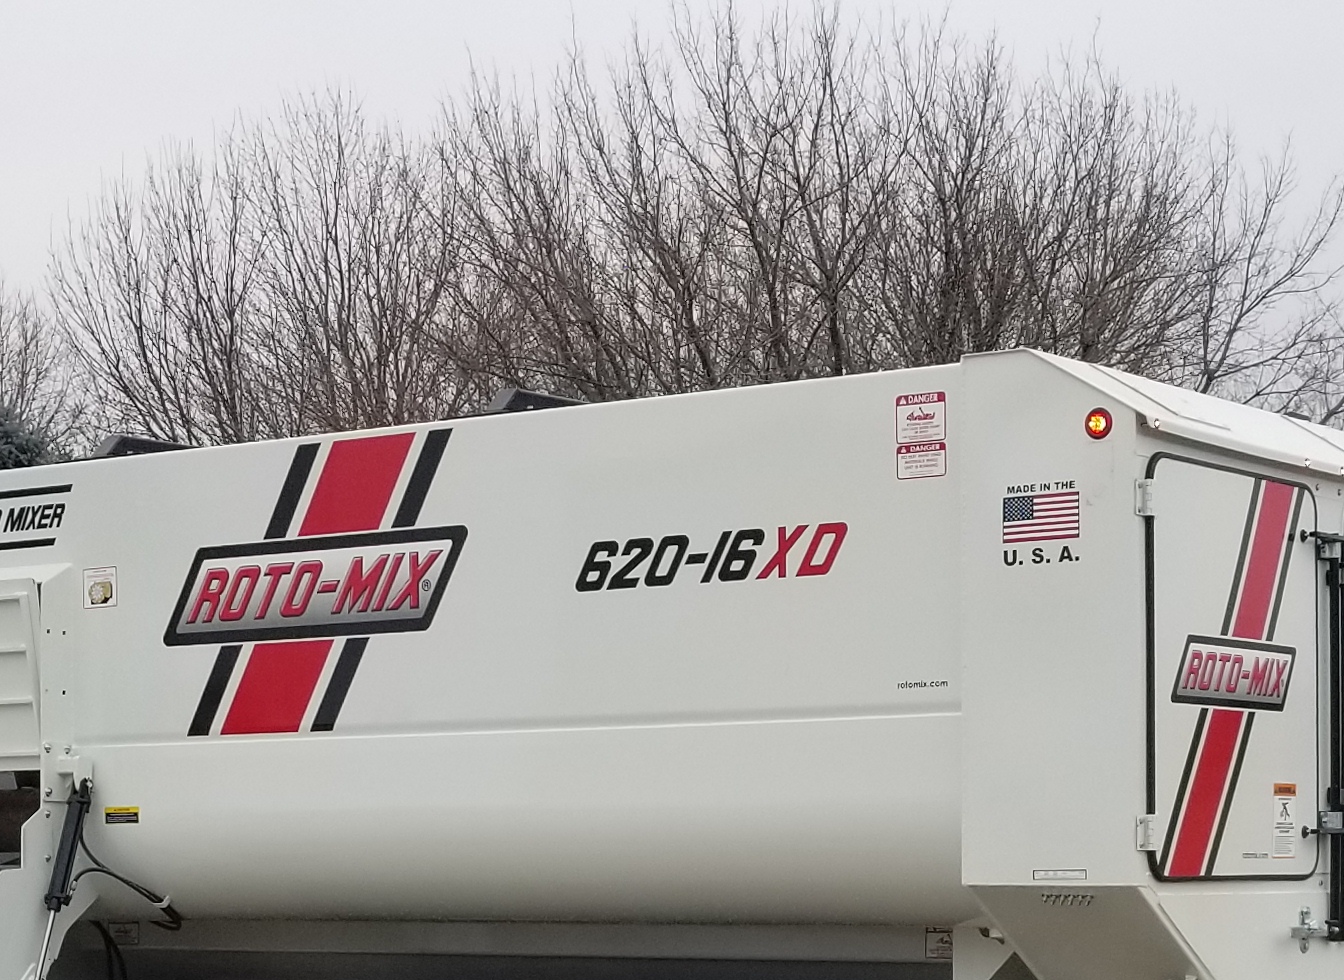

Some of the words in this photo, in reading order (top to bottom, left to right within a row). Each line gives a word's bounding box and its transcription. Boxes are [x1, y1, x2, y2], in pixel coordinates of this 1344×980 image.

[908, 393, 938, 404] DANGER
[1006, 483, 1036, 495] MADE
[1040, 482, 1051, 492] IN
[1054, 480, 1076, 490] THE
[3, 503, 66, 533] MIXER
[186, 549, 444, 624] ROTO-MIX
[1182, 649, 1288, 698] ROTO-MIX
[897, 680, 949, 690] rotomix.com
